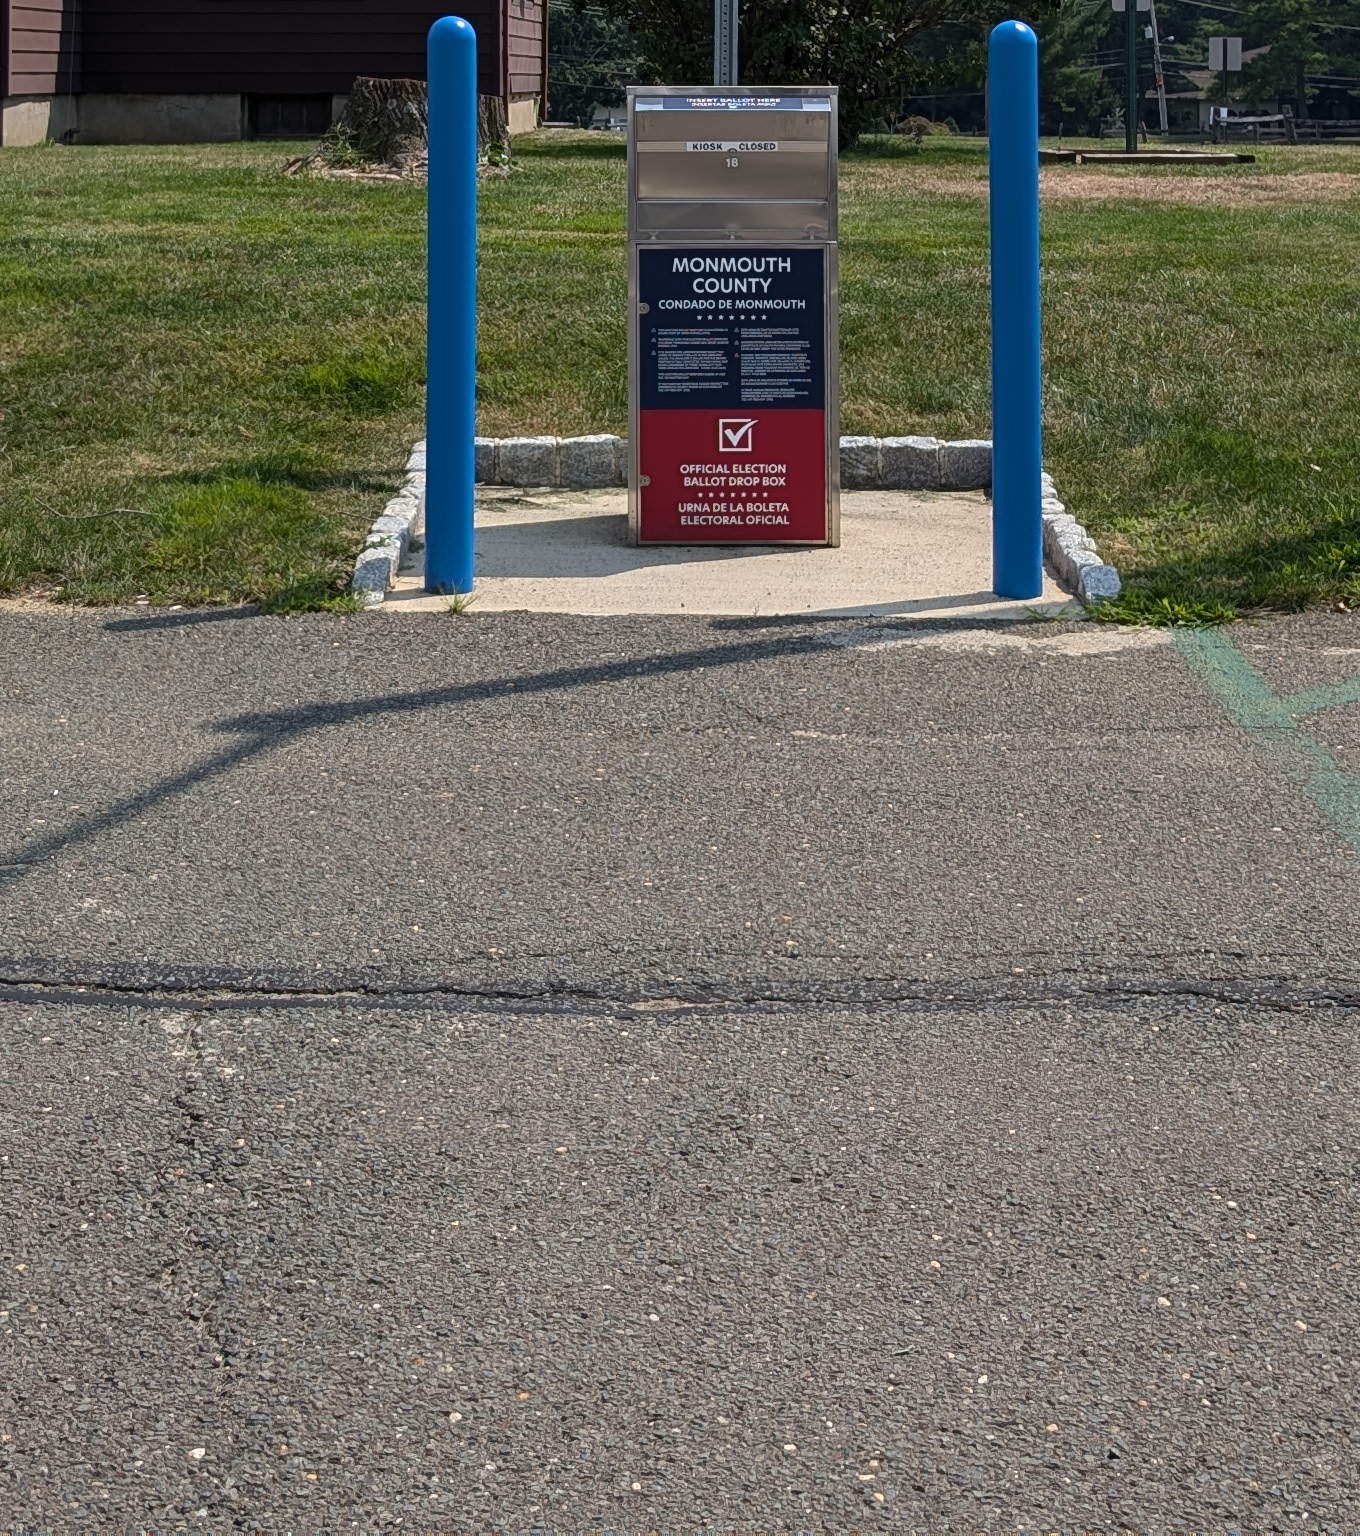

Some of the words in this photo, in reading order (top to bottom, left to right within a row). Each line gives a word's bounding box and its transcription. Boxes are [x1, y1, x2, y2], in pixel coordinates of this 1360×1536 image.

[692, 142, 723, 151] KIOSK
[738, 142, 776, 151] CLOSED
[672, 257, 791, 273] MONMOUTH
[692, 277, 772, 294] COUNTY
[658, 299, 716, 310] CONDADO
[718, 299, 732, 310] DE
[735, 299, 806, 310] MONMOUTH
[679, 464, 730, 474] OFFICIAL
[732, 464, 787, 474] ELECTION
[683, 476, 727, 487] BALLOT
[728, 476, 760, 487] DROP
[762, 476, 786, 487] BOX
[678, 502, 711, 513] URNA
[712, 502, 727, 513] DE
[729, 502, 744, 513] LA
[746, 502, 790, 513] BOLETA
[680, 515, 744, 526] ELECTORAL
[745, 515, 790, 526] OFICIAL
